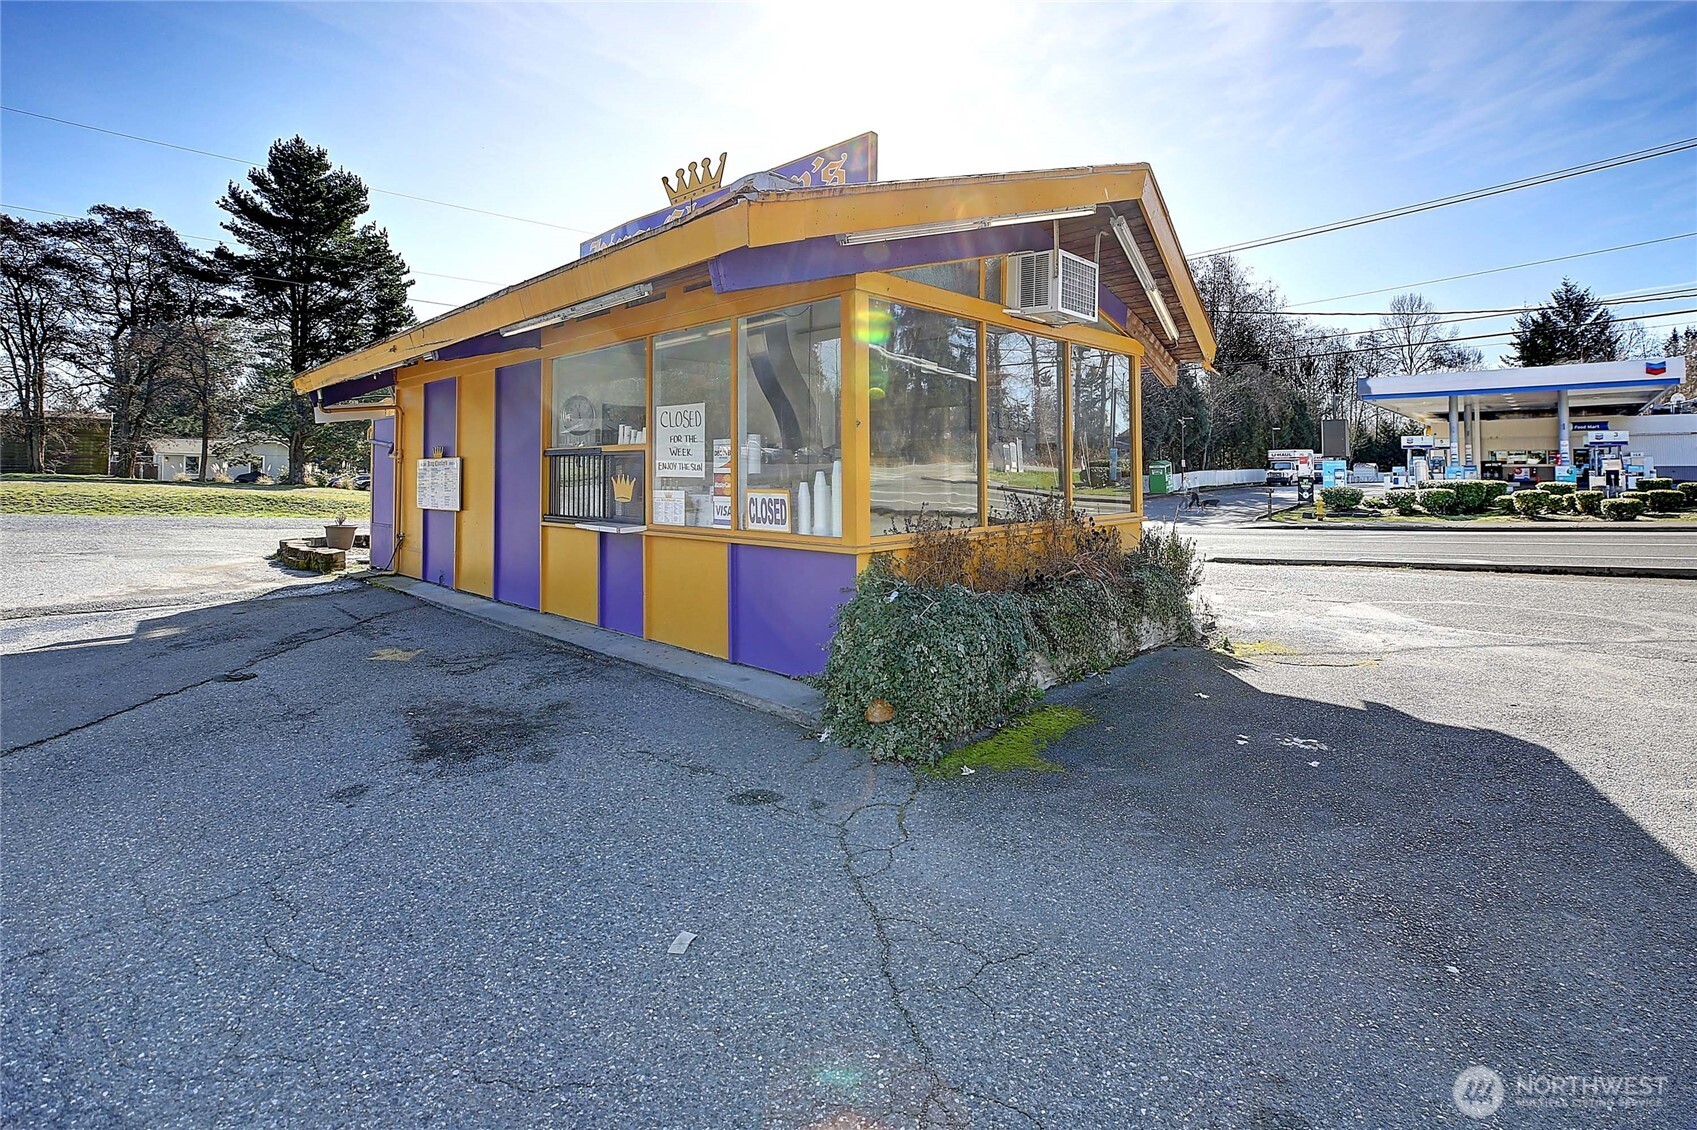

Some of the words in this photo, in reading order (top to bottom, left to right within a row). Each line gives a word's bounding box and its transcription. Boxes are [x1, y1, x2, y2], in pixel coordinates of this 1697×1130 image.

[660, 410, 702, 428] CLOSED
[669, 435, 683, 443] FOR
[684, 434, 698, 443] THE
[669, 447, 693, 457] WEEK
[658, 462, 677, 470] ENJOY
[690, 462, 703, 472] SUN
[749, 497, 787, 526] CLOSED
